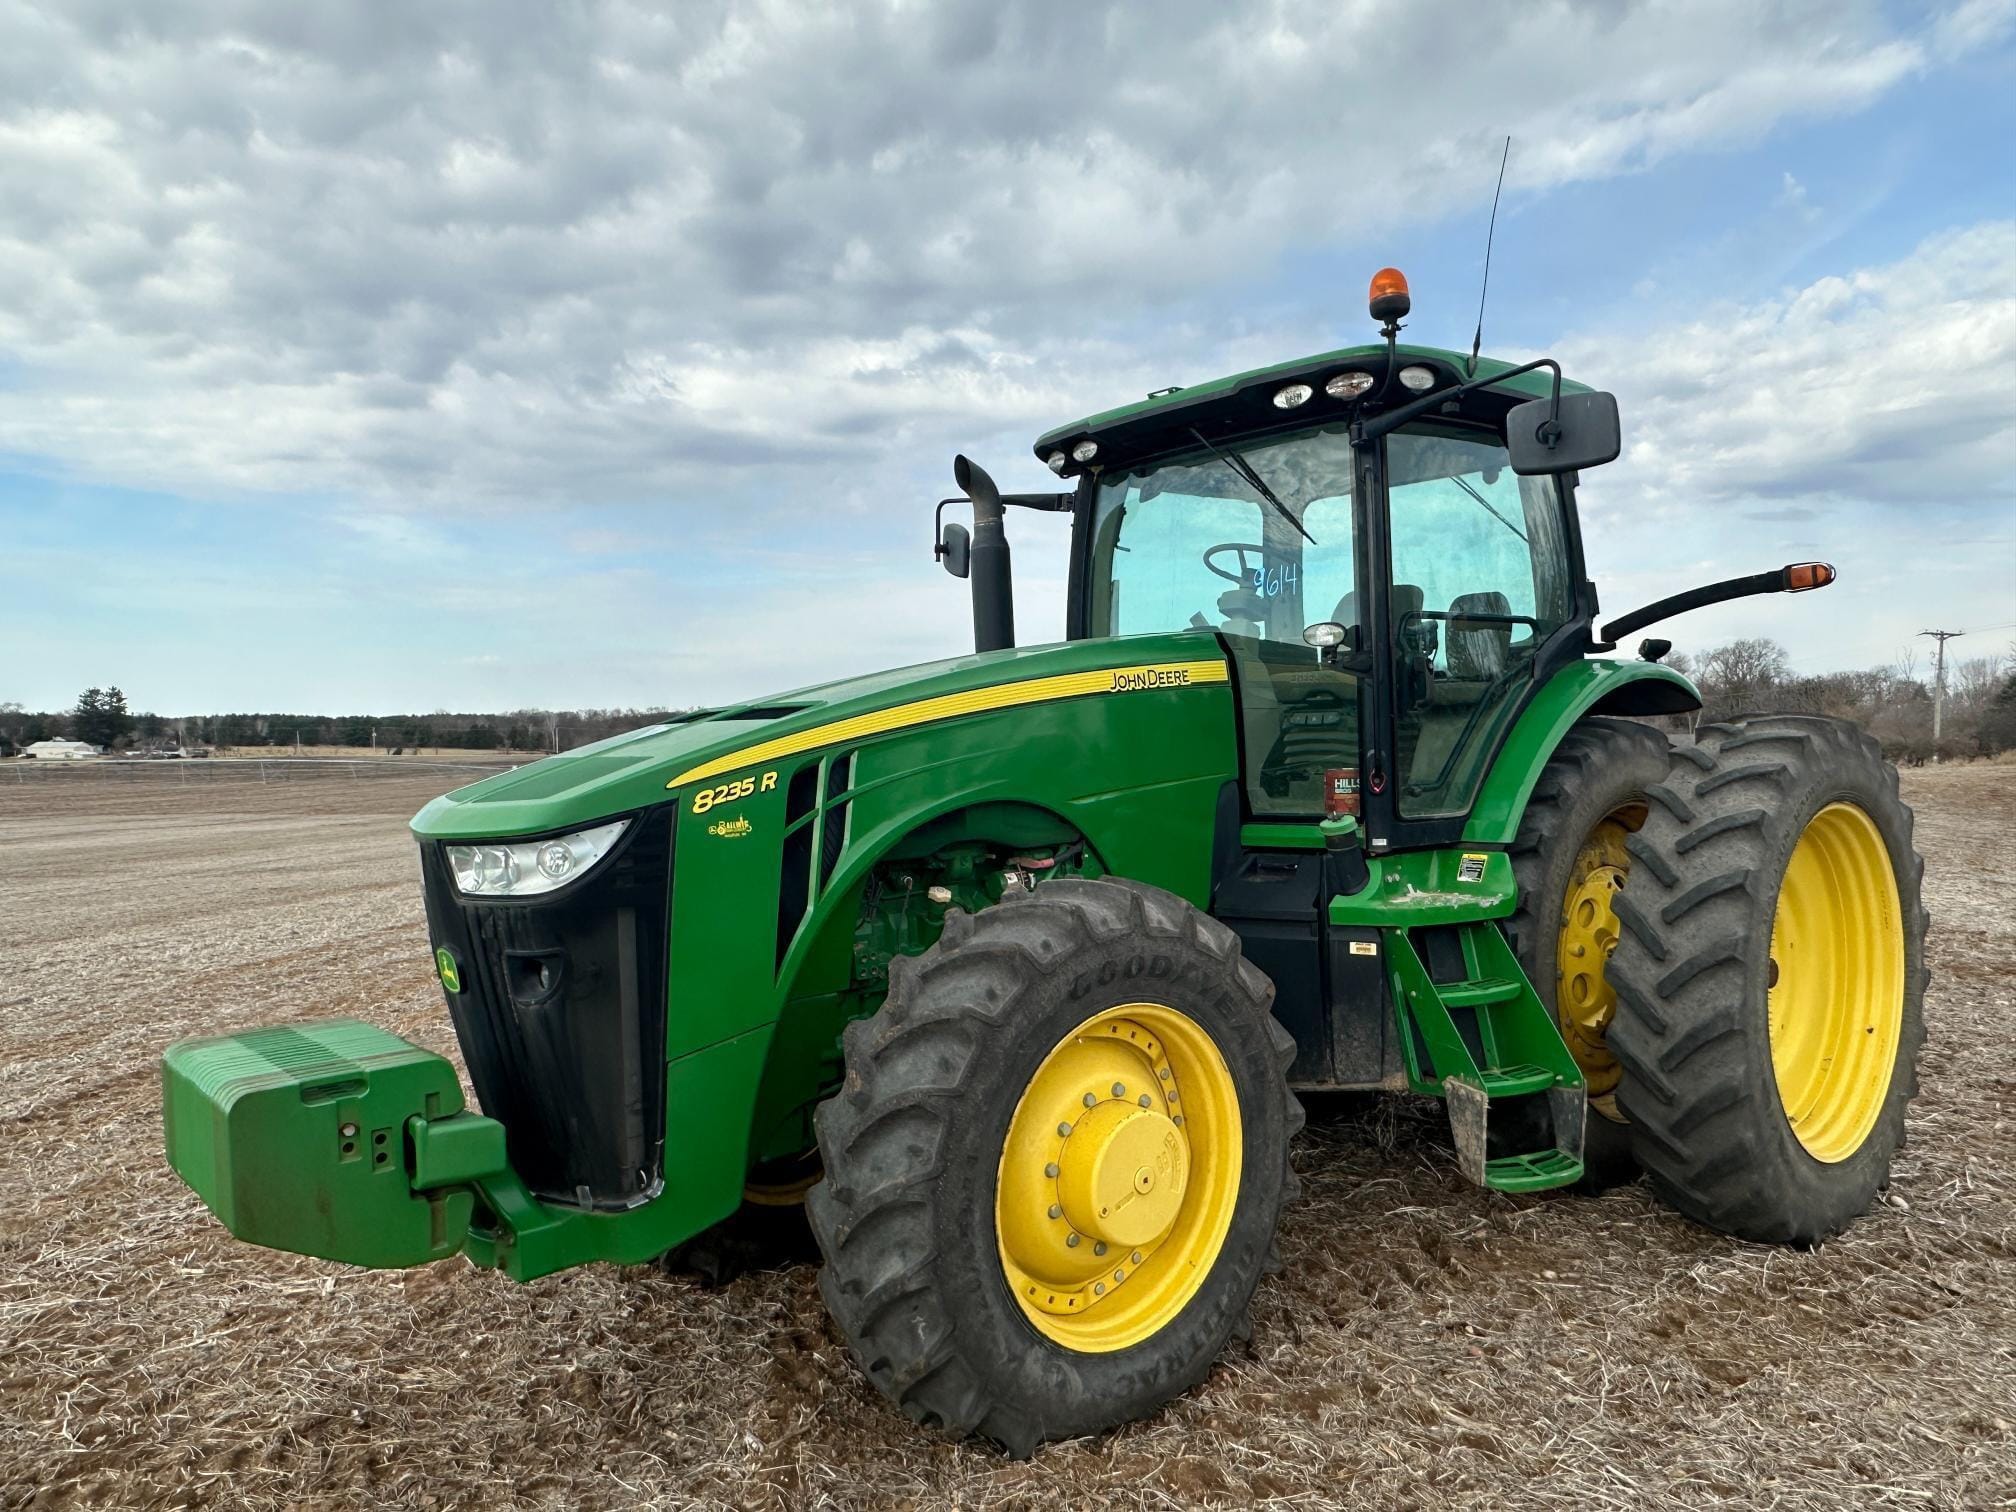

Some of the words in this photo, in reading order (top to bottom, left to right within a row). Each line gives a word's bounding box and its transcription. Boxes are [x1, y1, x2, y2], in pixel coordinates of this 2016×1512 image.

[1254, 562, 1297, 599] 9614
[1110, 671, 1146, 690] JOHN
[1147, 669, 1190, 686] DEERE
[691, 776, 755, 814] 8235
[760, 771, 778, 792] R
